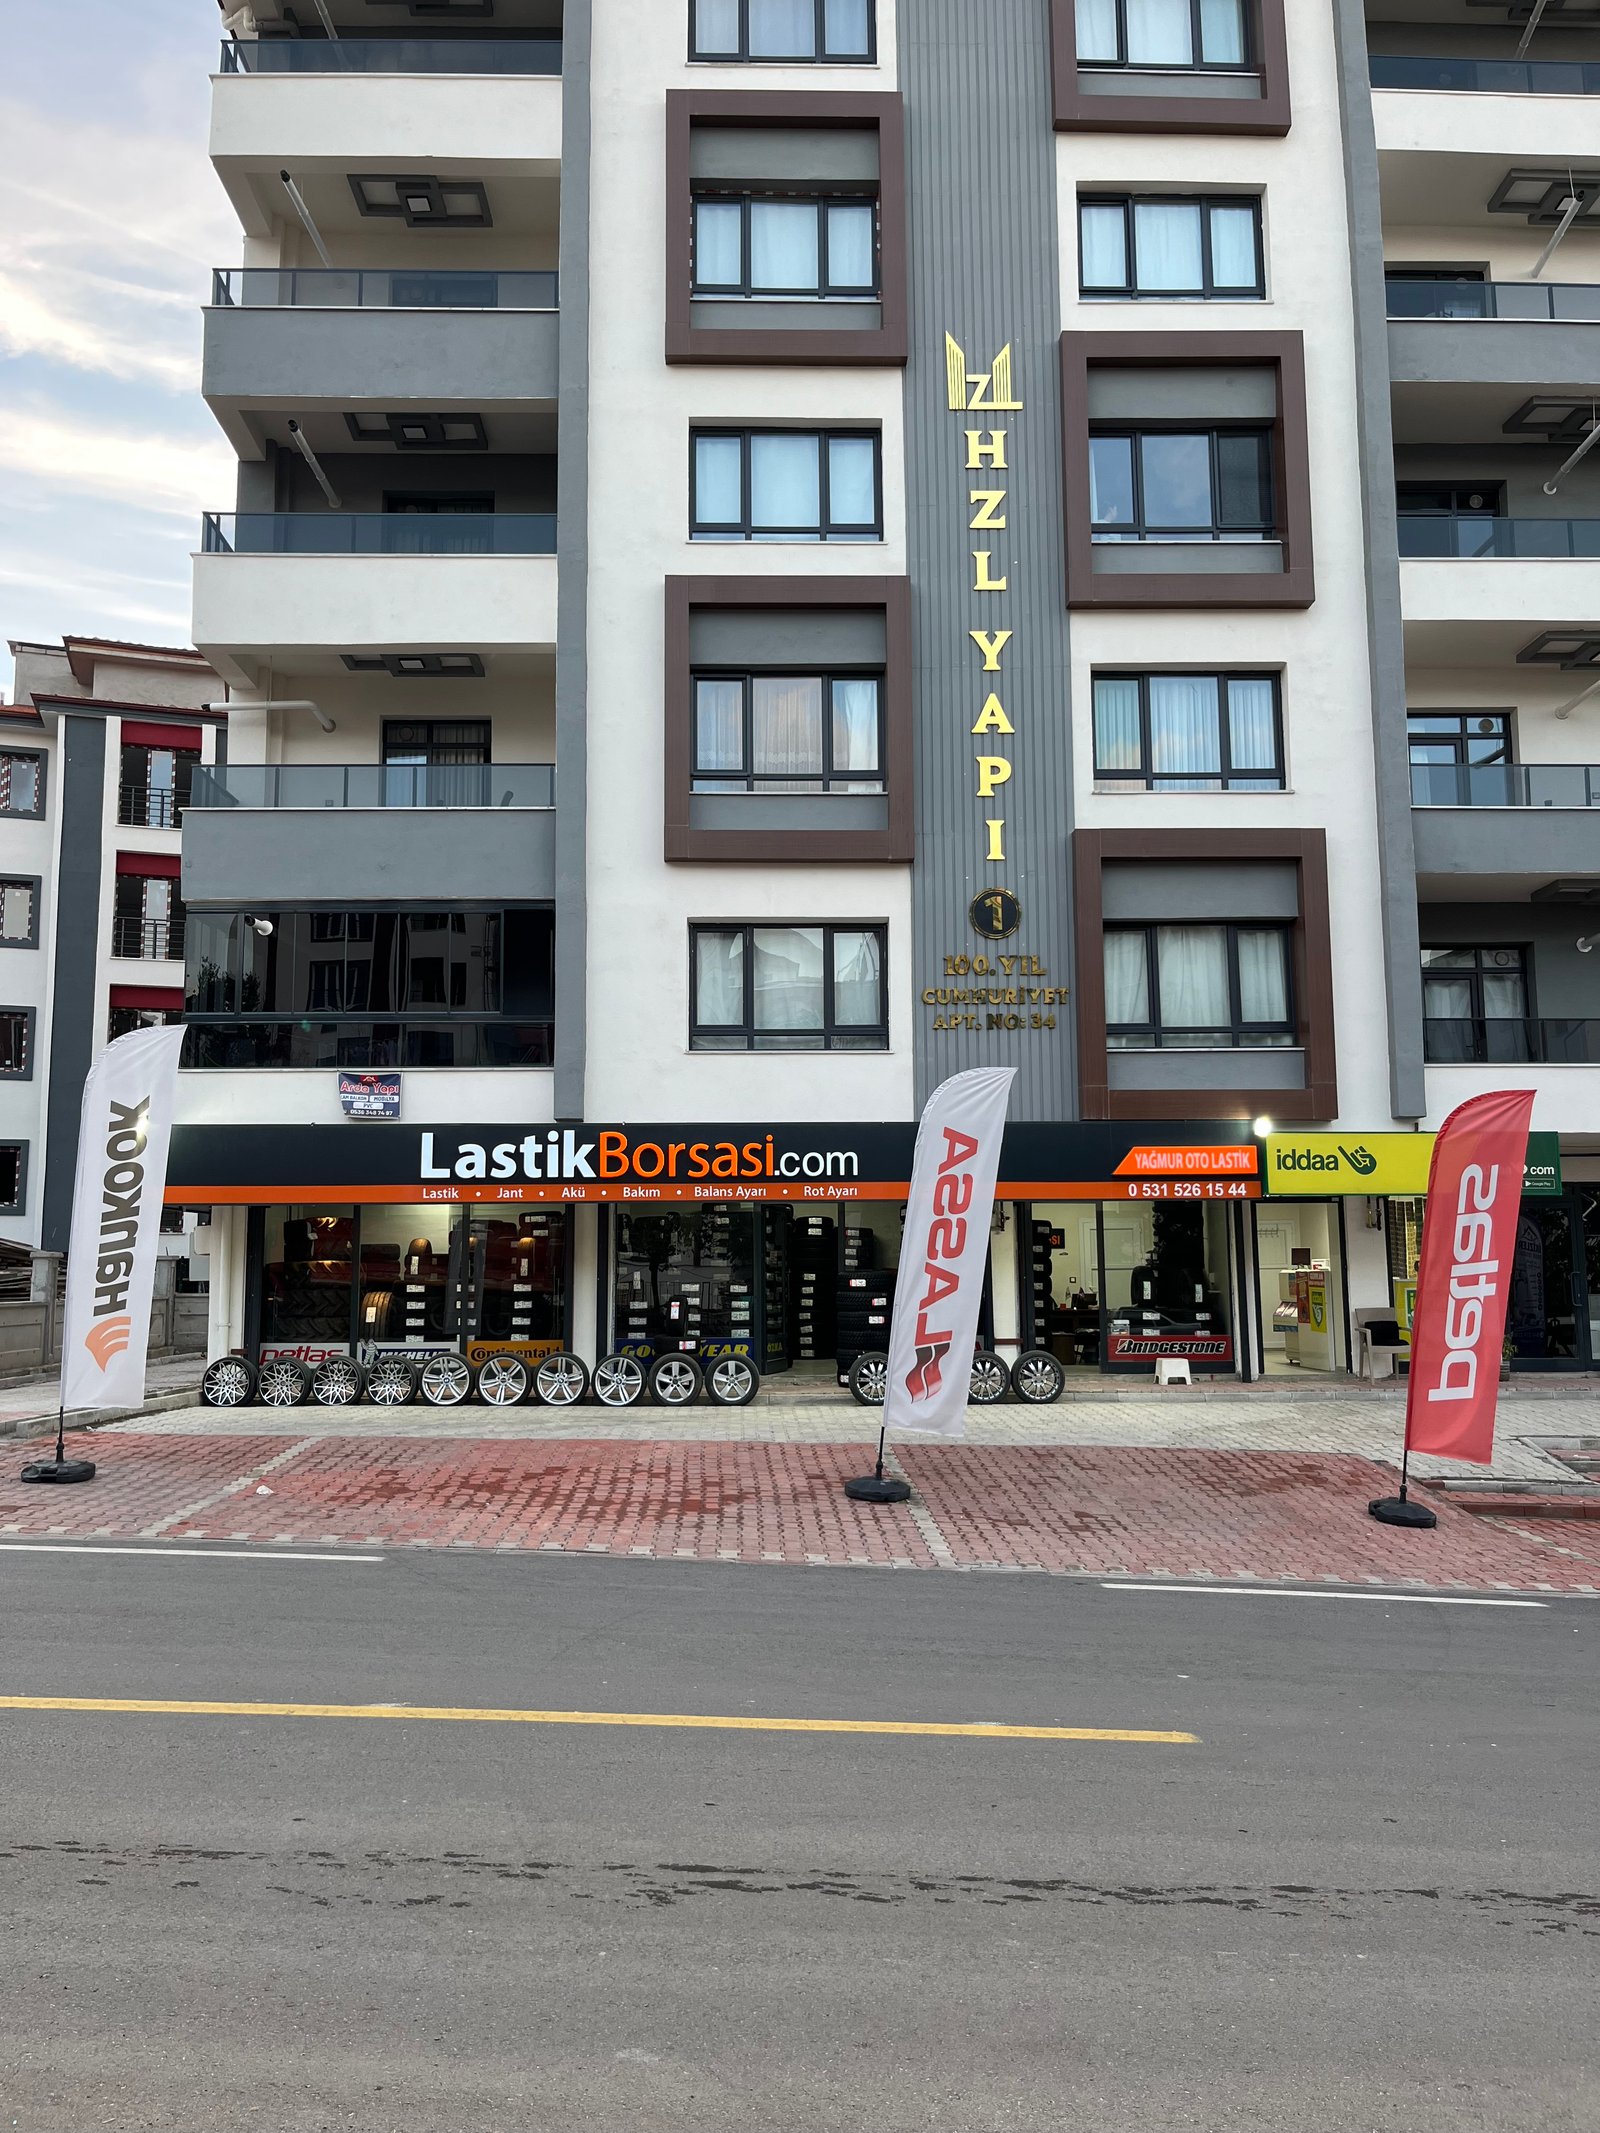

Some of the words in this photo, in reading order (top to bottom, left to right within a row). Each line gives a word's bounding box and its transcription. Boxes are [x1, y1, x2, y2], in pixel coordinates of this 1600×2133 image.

[984, 896, 1003, 931] 1
[933, 1014, 982, 1031] APT.
[1031, 1012, 1056, 1029] 34
[340, 1081, 369, 1093] Arda
[1135, 1150, 1184, 1169] YAĞMUR
[1185, 1152, 1210, 1169] OTO
[1211, 1149, 1251, 1169] LASTİK
[1276, 1149, 1339, 1171] iddaa
[422, 1187, 459, 1199] Lastik
[497, 1187, 524, 1198] Jant
[561, 1187, 586, 1198] Akü
[623, 1186, 661, 1198] Bakım
[694, 1186, 733, 1197] Balans
[736, 1187, 767, 1199] Ayarı
[804, 1186, 825, 1197] Rot
[827, 1186, 858, 1198] Ayarı
[1128, 1184, 1138, 1197] 0
[1142, 1183, 1168, 1197] 531
[1174, 1183, 1202, 1197] 526
[1206, 1183, 1224, 1196] 15
[1228, 1183, 1247, 1196] 44
[1116, 1339, 1226, 1354] BRIDGESTONE
